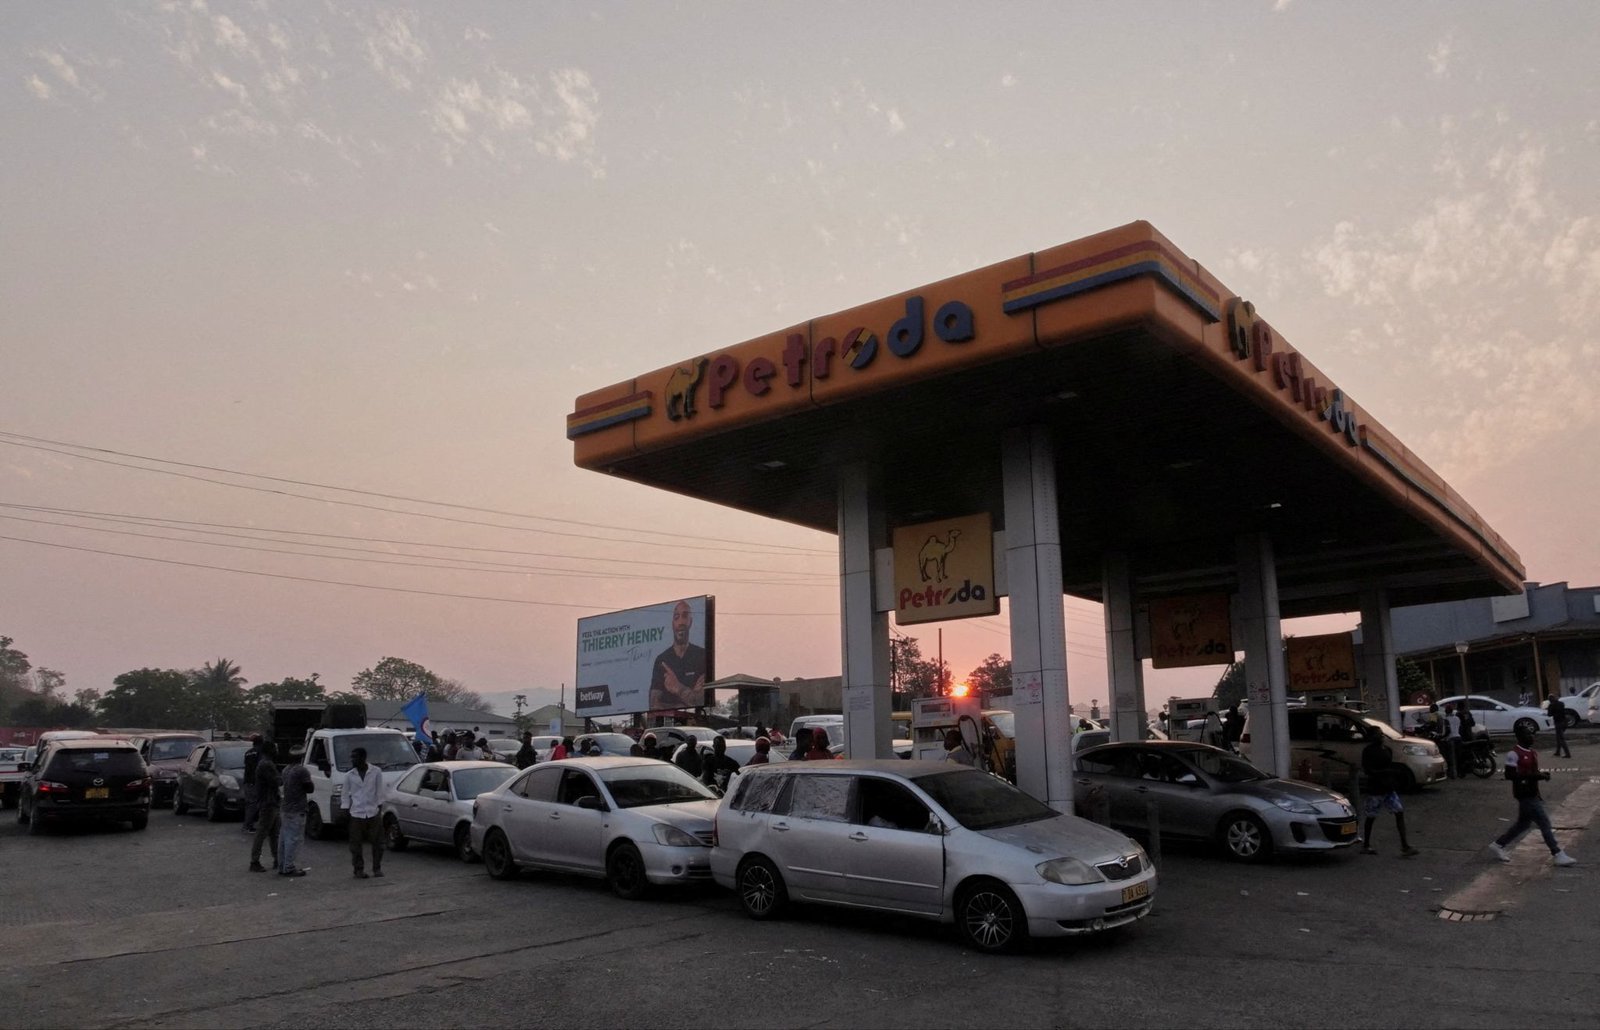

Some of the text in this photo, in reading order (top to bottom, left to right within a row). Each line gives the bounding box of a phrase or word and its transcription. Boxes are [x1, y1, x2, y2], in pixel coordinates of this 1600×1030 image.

[709, 295, 976, 409] Petroda
[899, 579, 985, 610] Petroda
[582, 626, 665, 653] THIERRY HENRY
[580, 691, 605, 702] betway
